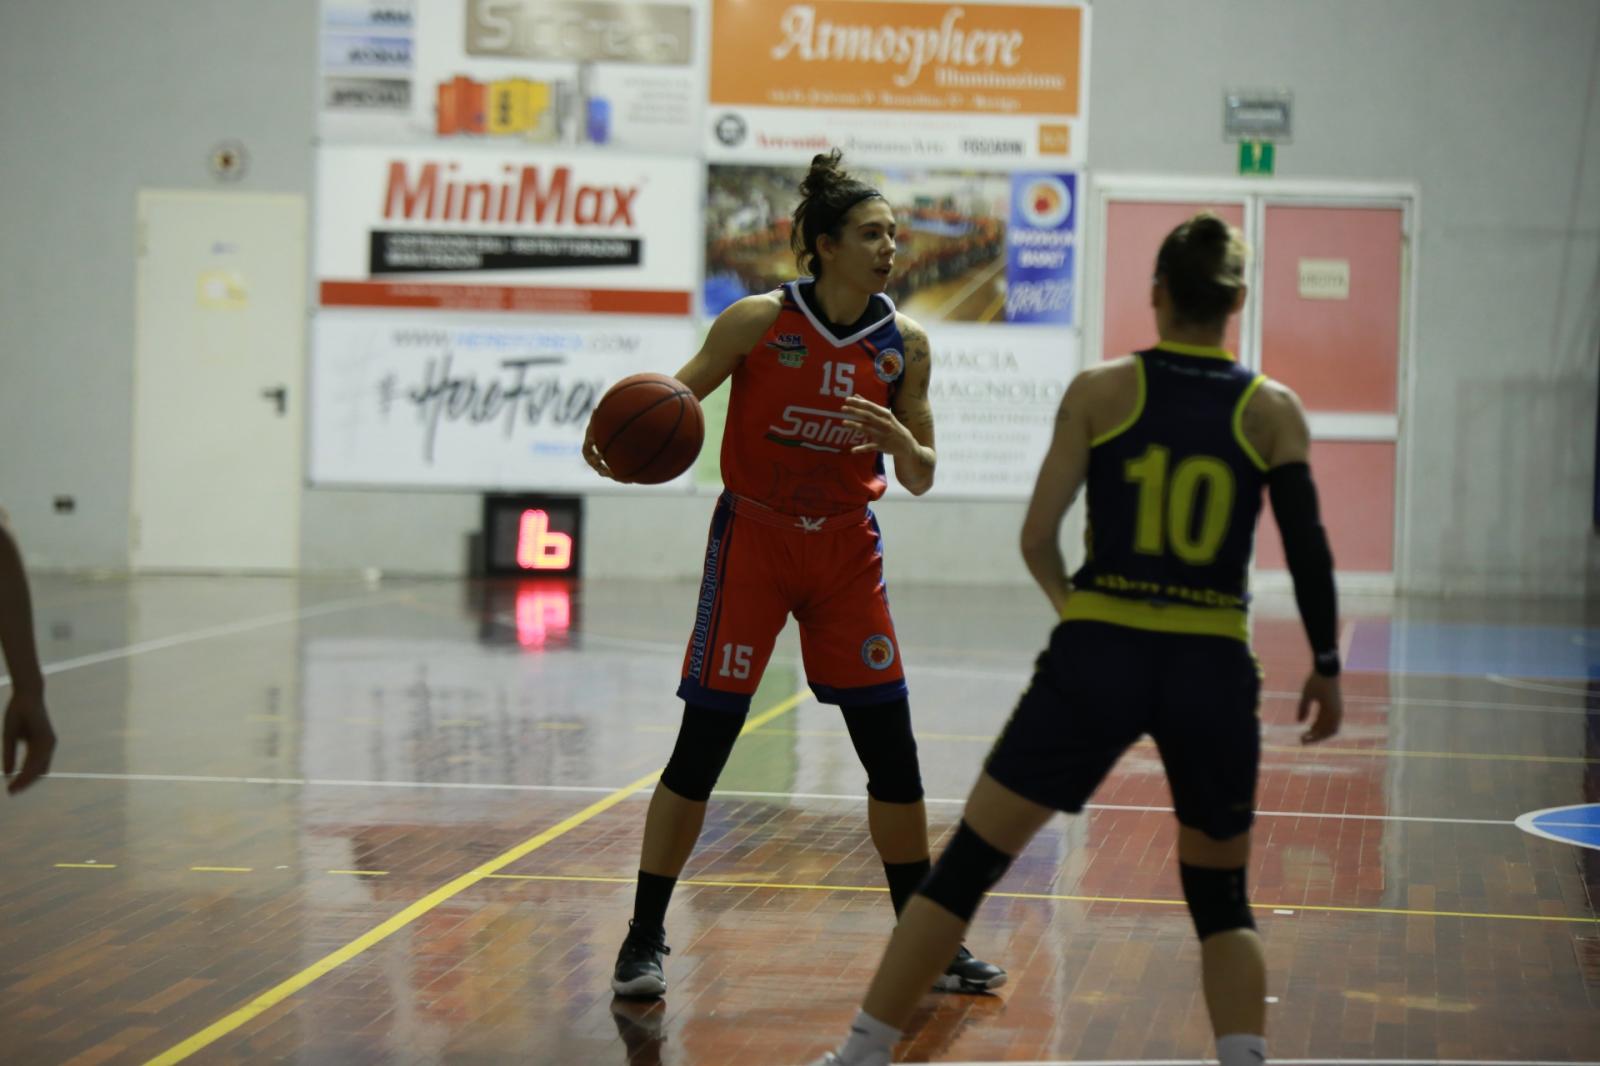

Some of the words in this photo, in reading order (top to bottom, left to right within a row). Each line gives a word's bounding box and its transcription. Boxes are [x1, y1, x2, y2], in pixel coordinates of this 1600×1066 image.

[770, 5, 1024, 87] Atmosphere
[382, 158, 638, 227] MiniMax
[777, 335, 803, 345] ASM
[819, 360, 856, 398] 15
[1123, 441, 1236, 565] 10
[718, 643, 754, 681] 15
